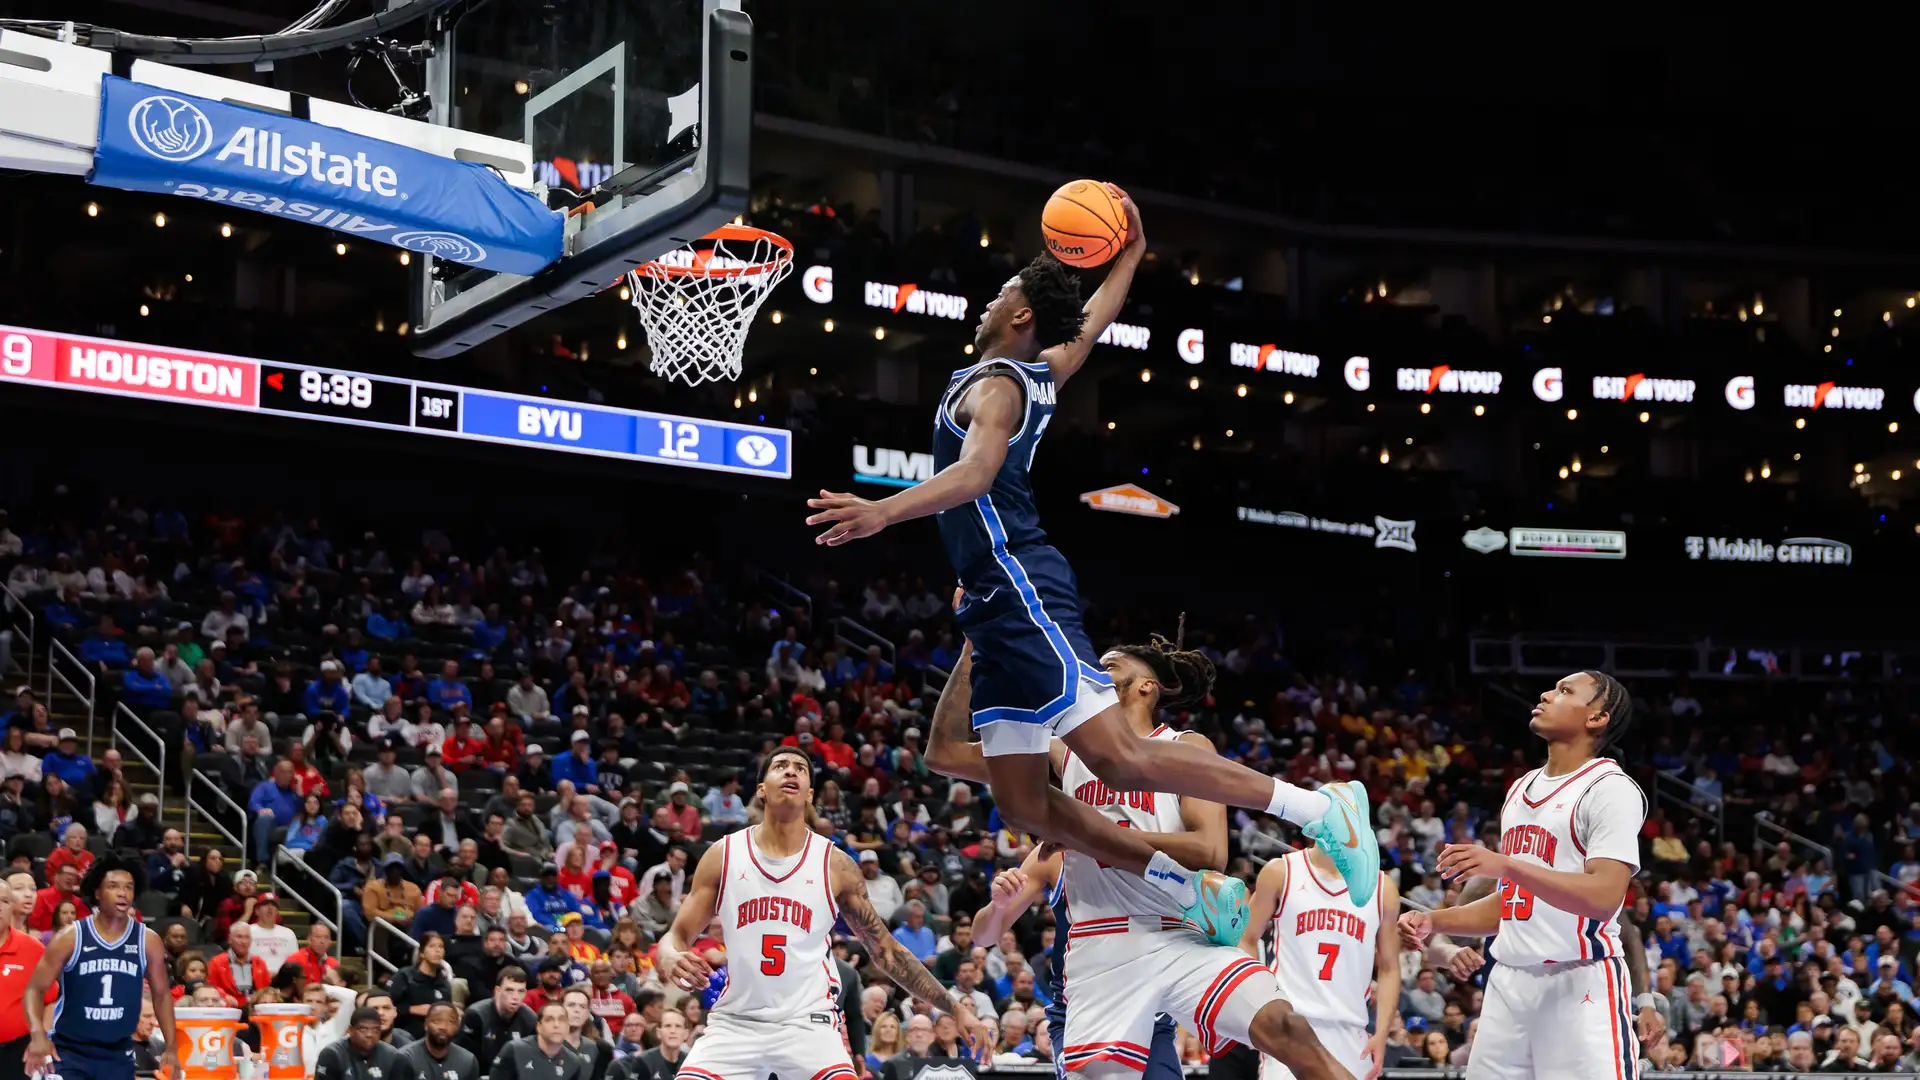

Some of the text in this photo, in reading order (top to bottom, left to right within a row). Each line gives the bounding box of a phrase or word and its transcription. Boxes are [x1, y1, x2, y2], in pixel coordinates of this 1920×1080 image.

[215, 126, 399, 198] Allstate
[173, 183, 397, 232] Allstate
[802, 265, 833, 304] G
[925, 290, 969, 321] YOU?
[3, 334, 33, 376] 9
[1177, 328, 1205, 365] G
[1283, 350, 1320, 378] YOU?
[69, 346, 243, 398] HOUSTON
[300, 370, 372, 409] 9:39
[1344, 356, 1370, 391] G
[1458, 369, 1503, 395] YOU?
[1532, 367, 1563, 402] G
[1653, 378, 1697, 402] YOU?
[420, 396, 454, 419] 1ST
[1725, 376, 1755, 410] G
[1842, 386, 1885, 411] YOU?
[517, 404, 582, 441] BYU
[658, 420, 700, 461] 12
[1706, 537, 1775, 563] Mobile
[1776, 544, 1846, 565] CENTER
[736, 896, 813, 933] HOUSTON
[1295, 908, 1367, 945] HOUSTON
[79, 958, 138, 977] BRIGHAM
[760, 934, 787, 976] 5
[1317, 942, 1340, 981] 7
[99, 974, 114, 1006] 1
[84, 1006, 125, 1021] YOUNG
